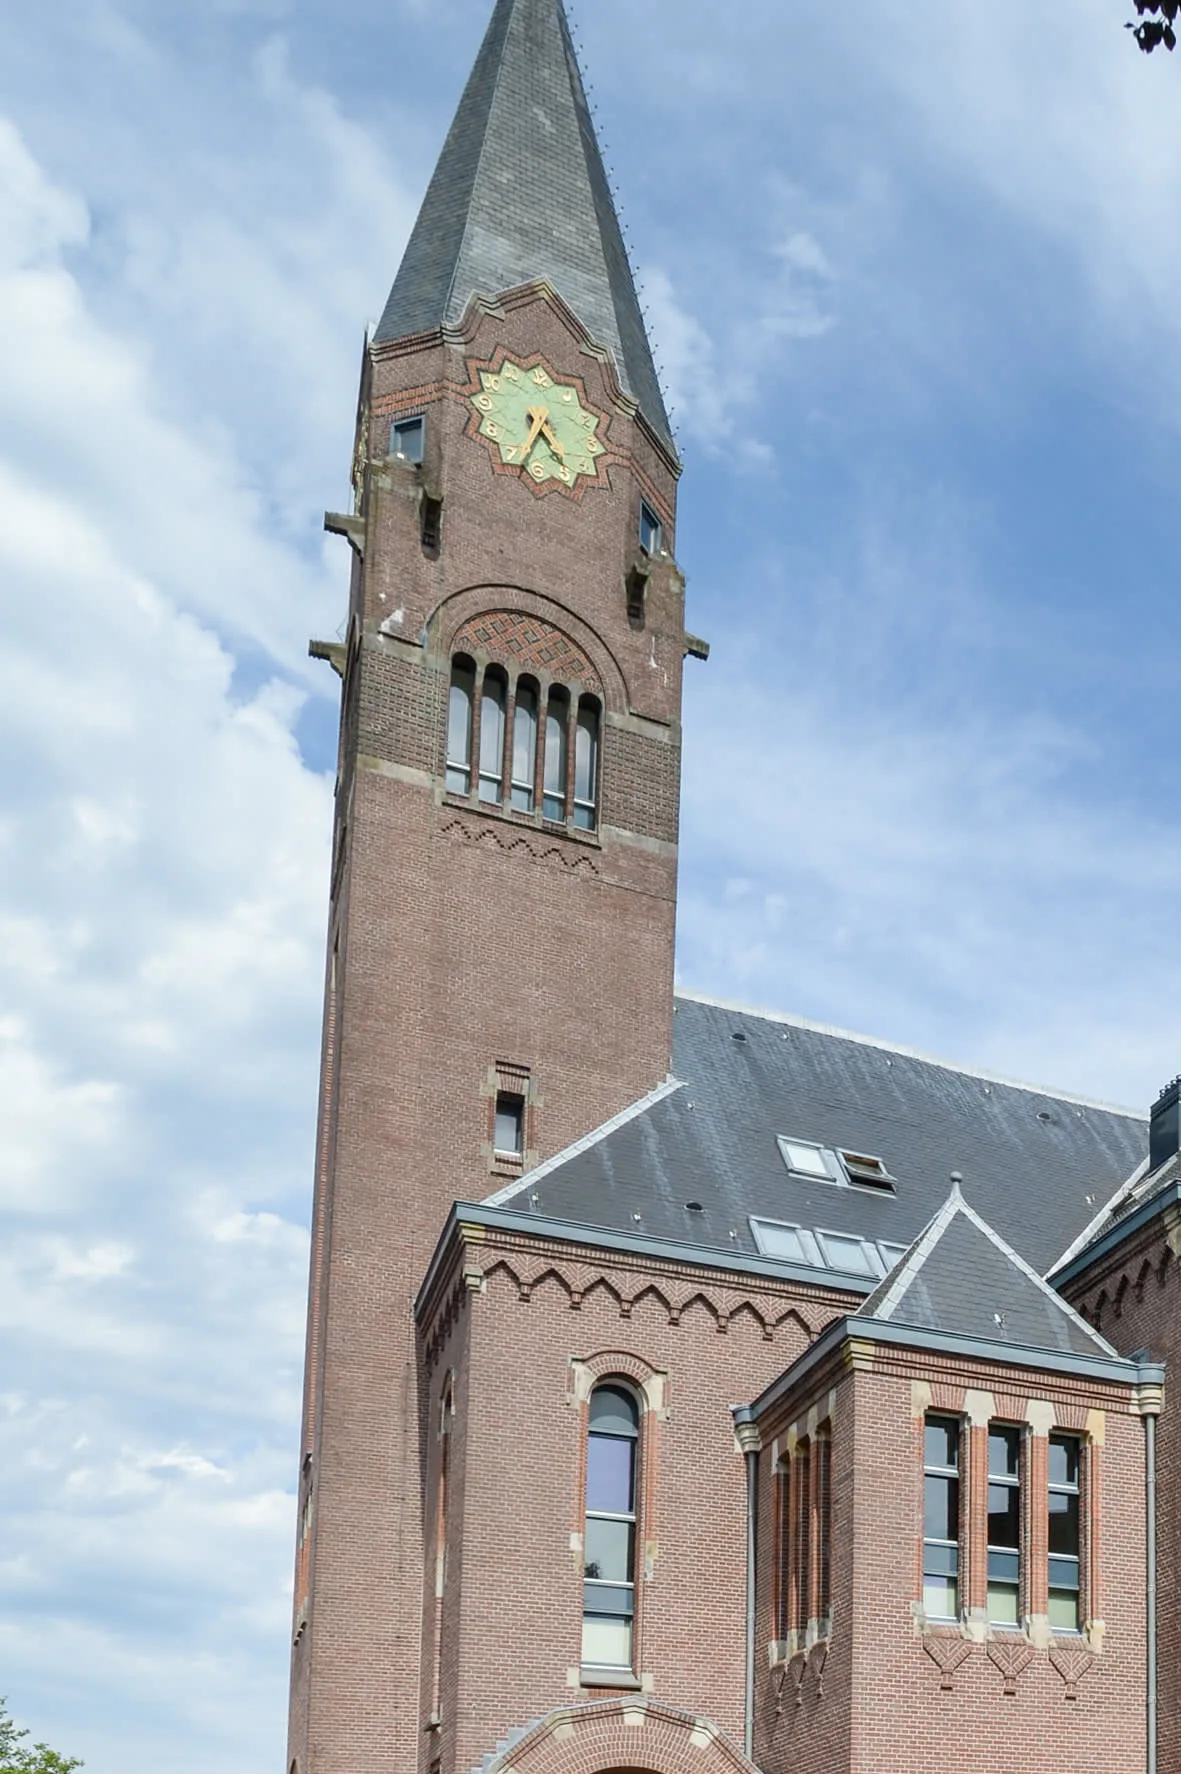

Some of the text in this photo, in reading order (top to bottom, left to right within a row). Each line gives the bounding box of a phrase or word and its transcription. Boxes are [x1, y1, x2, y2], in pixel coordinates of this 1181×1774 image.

[484, 374, 500, 392] 10
[479, 395, 493, 411] 9
[485, 421, 497, 437] 8
[586, 436, 598, 452] 3
[506, 446, 518, 461] 7
[532, 460, 545, 478] 6
[558, 464, 570, 481] 5
